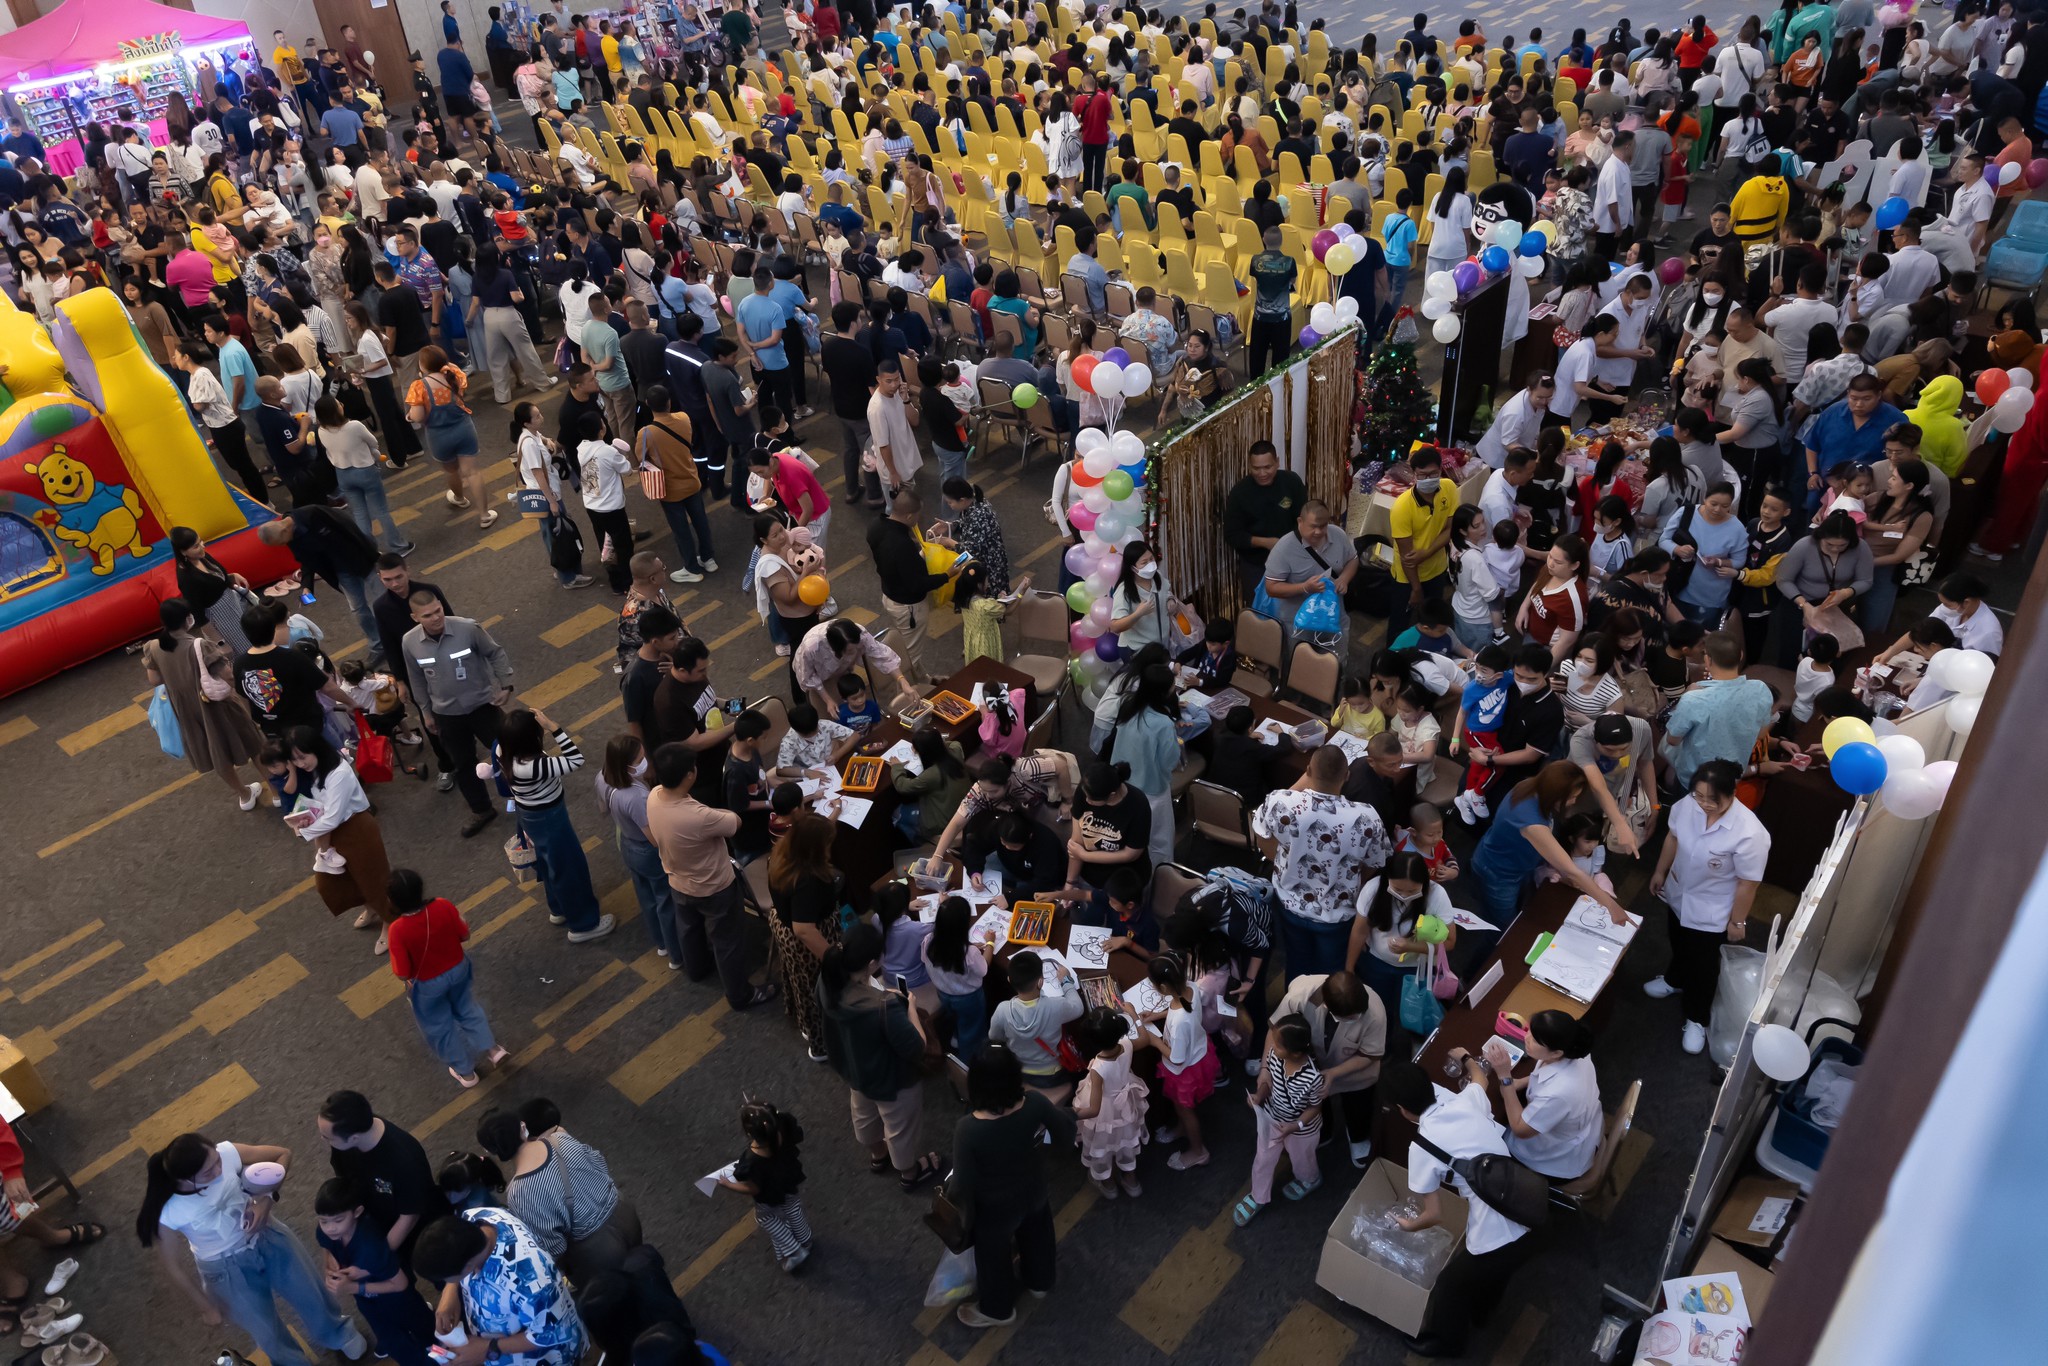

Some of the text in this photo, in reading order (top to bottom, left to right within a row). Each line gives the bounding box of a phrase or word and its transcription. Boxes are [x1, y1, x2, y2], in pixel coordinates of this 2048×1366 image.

[205, 128, 217, 141] 30
[284, 429, 292, 439] 9
[1479, 688, 1505, 712] NIKE
